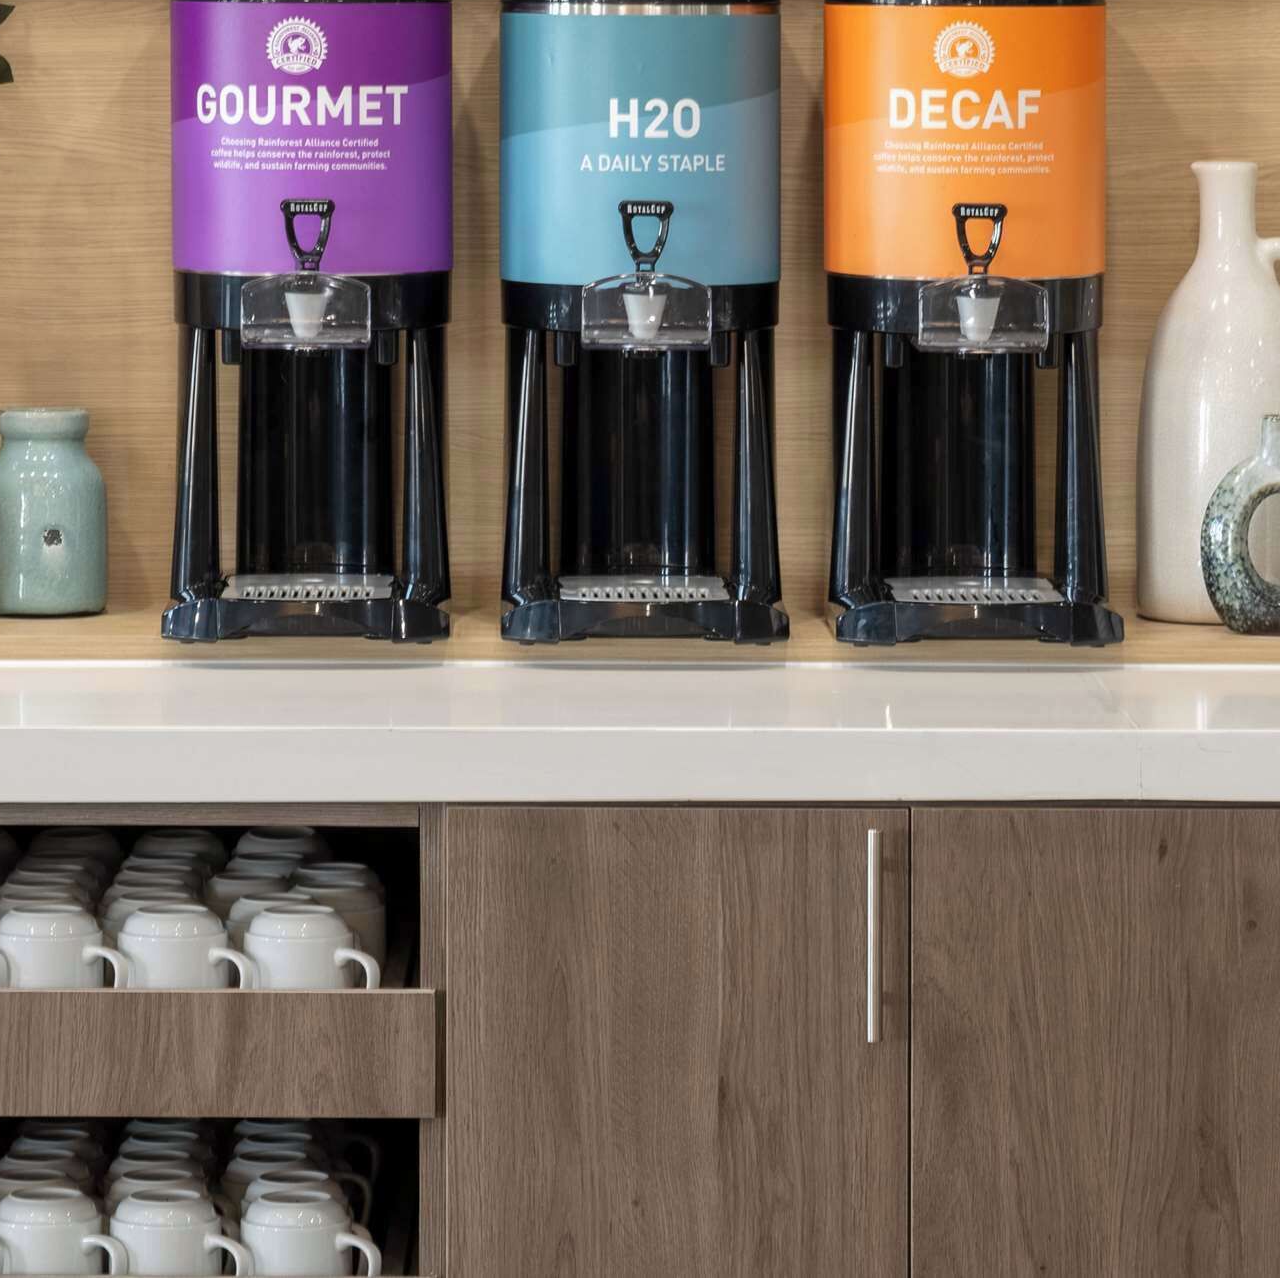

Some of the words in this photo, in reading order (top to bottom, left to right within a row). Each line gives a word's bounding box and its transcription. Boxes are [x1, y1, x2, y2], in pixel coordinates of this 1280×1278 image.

[196, 83, 409, 126] GOURMET
[888, 88, 1042, 130] DECAF
[220, 137, 257, 148] Choosing
[258, 137, 303, 147] Rainforest
[304, 138, 341, 147] Alliance
[342, 137, 380, 147] Certified
[210, 149, 233, 159] coffee
[257, 151, 296, 159] conserve
[298, 150, 313, 159] the
[315, 150, 361, 161] rainforest,
[362, 150, 391, 161] protect
[964, 154, 978, 162] the
[244, 161, 260, 170] and
[261, 162, 293, 171] sustain
[294, 162, 330, 173] farming
[580, 154, 593, 172] A
[598, 154, 653, 172] DAILY
[656, 154, 726, 172] STAPLE
